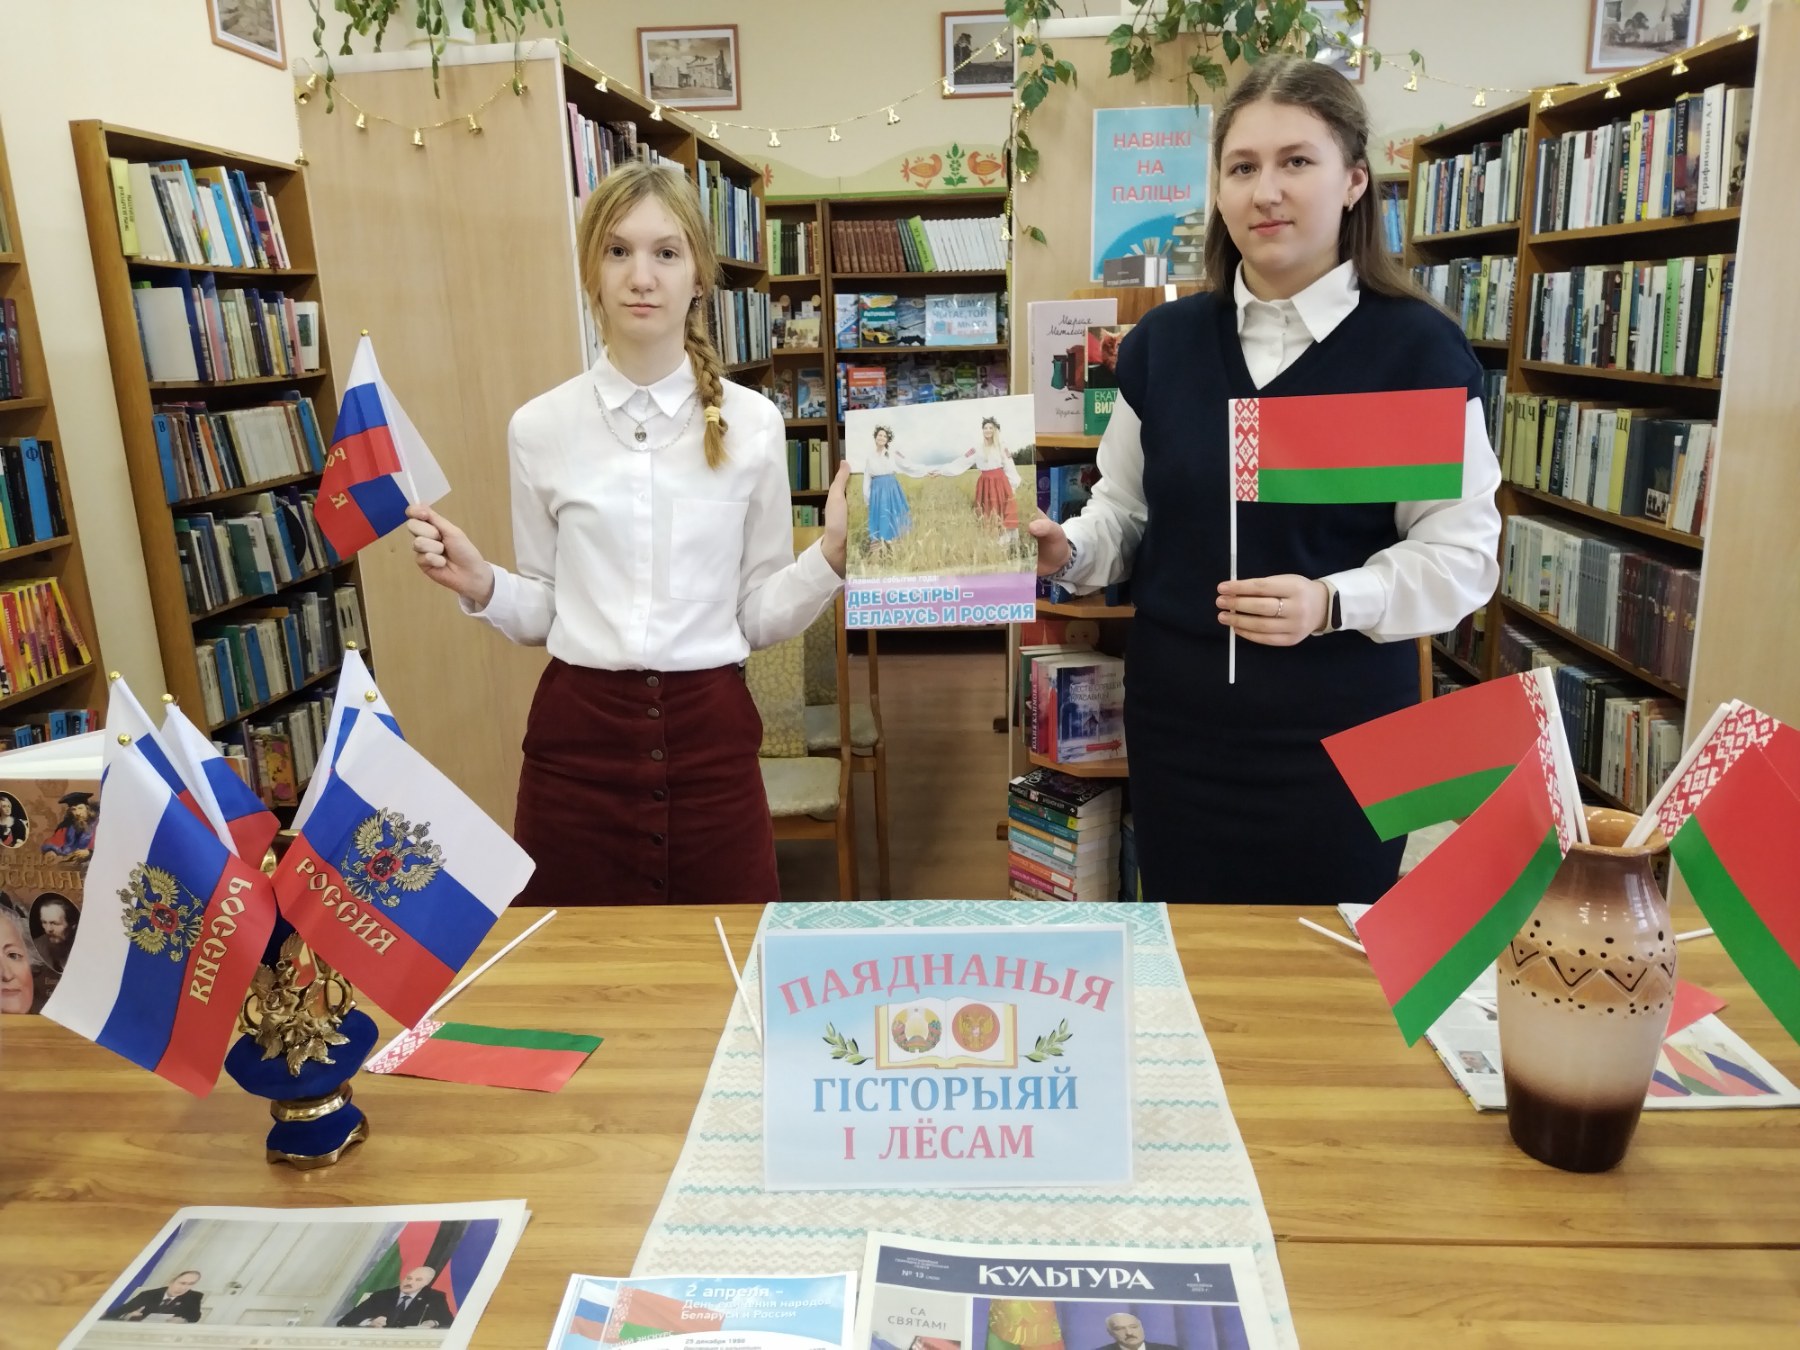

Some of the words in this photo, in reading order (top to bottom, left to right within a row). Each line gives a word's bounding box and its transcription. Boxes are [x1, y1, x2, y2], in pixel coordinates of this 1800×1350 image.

[1113, 131, 1192, 150] НАВІНКІ
[1137, 160, 1164, 176] НА
[1112, 184, 1191, 203] ПАЛІЦЫ
[1094, 390, 1118, 401] ЕКАТ
[1094, 401, 1115, 414] ВИЛ
[25, 446, 39, 462] Ф
[847, 590, 882, 609] ДВЕ
[886, 587, 960, 605] СЕСТРЫ
[847, 608, 939, 627] БЕЛАРУСЬ
[943, 607, 955, 624] И
[960, 604, 1036, 623] РОССИЯ
[55, 719, 64, 735] Я
[295, 857, 398, 956] РОССИЯ
[777, 953, 1115, 1015] ПАЯДНАНЫЯ
[812, 1066, 1079, 1113] ГІСТОРЫЯЙ
[843, 1126, 856, 1160] І
[878, 1118, 1036, 1160] ЛЁСАМ
[978, 1265, 1155, 1290] КУЛЬТУРА
[1193, 1273, 1200, 1282] 1
[685, 1284, 697, 1298] 2
[702, 1285, 771, 1301] апреля
[781, 1297, 832, 1309] народов
[909, 1306, 927, 1317] СА
[681, 1309, 743, 1321] Беларуси
[753, 1309, 798, 1319] России
